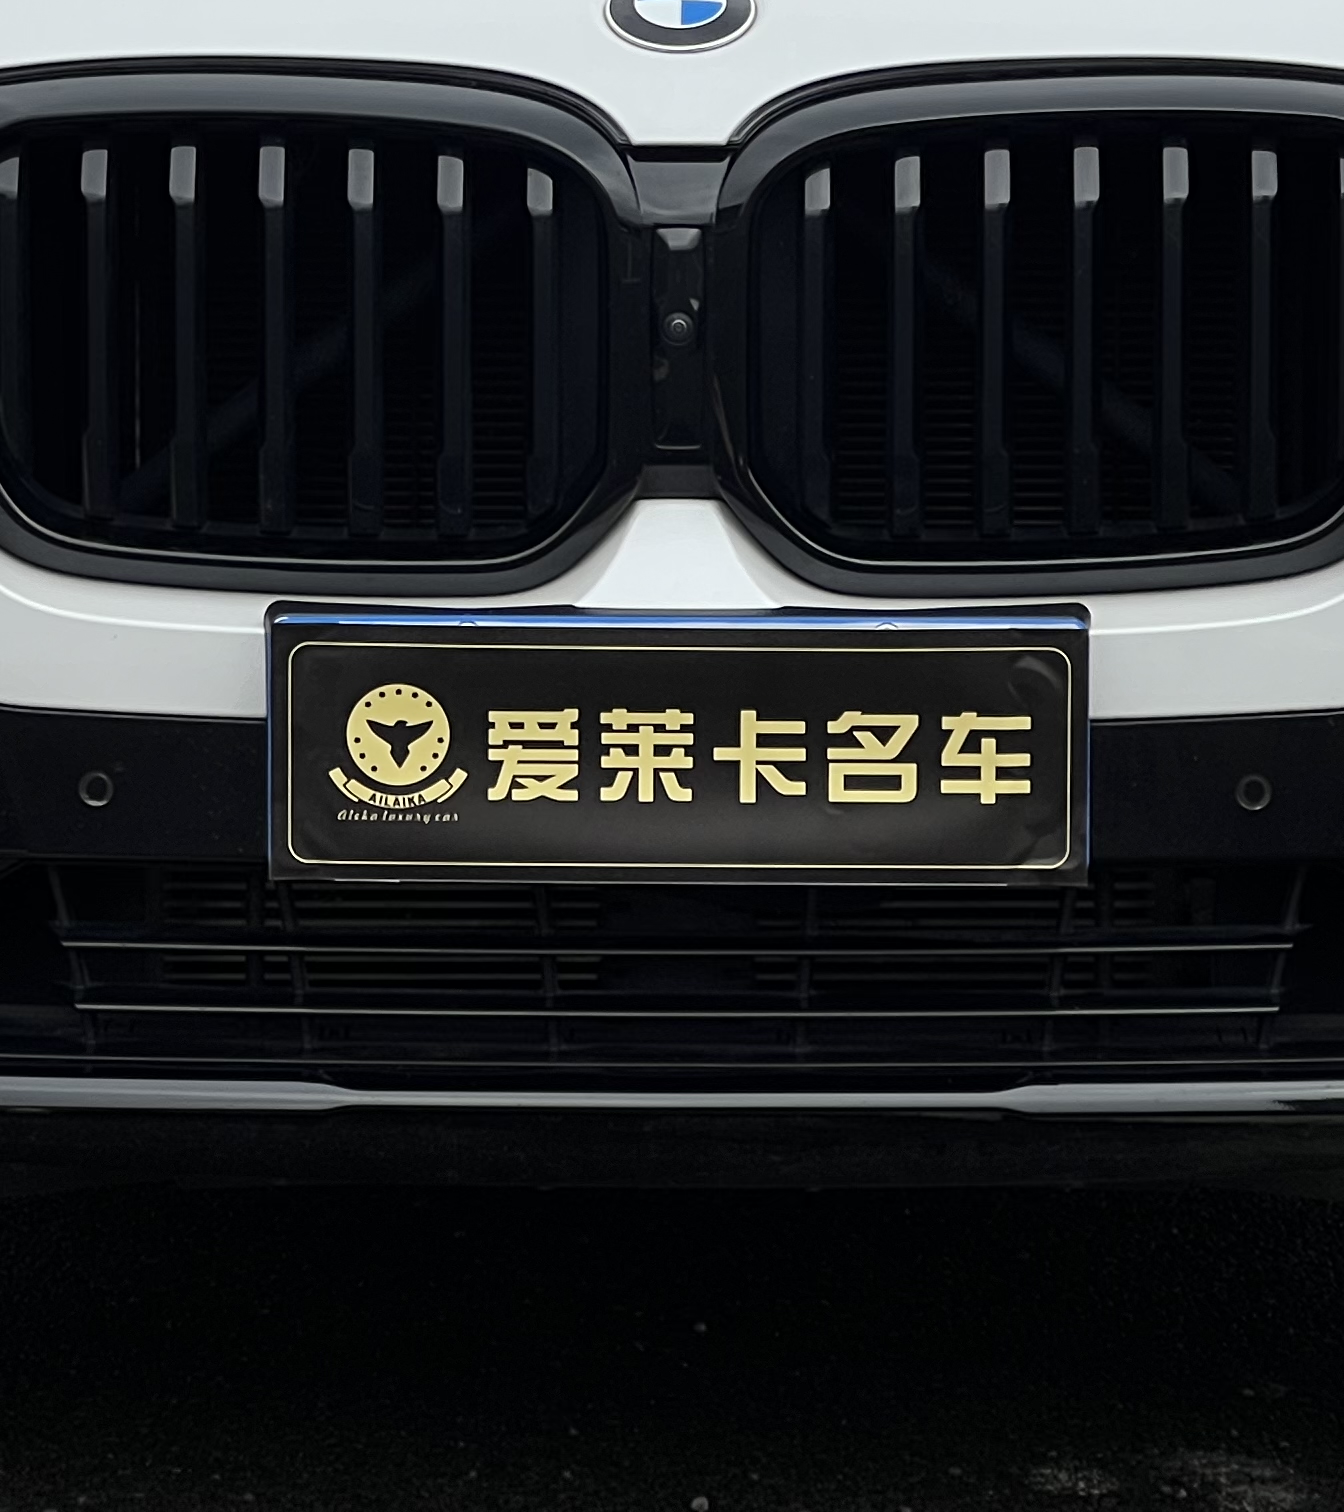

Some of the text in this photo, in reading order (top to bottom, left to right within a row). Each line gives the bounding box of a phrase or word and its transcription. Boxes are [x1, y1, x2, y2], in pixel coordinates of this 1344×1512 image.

[487, 706, 1032, 805] 爱莱卡名车
[368, 793, 426, 808] AILAIKA
